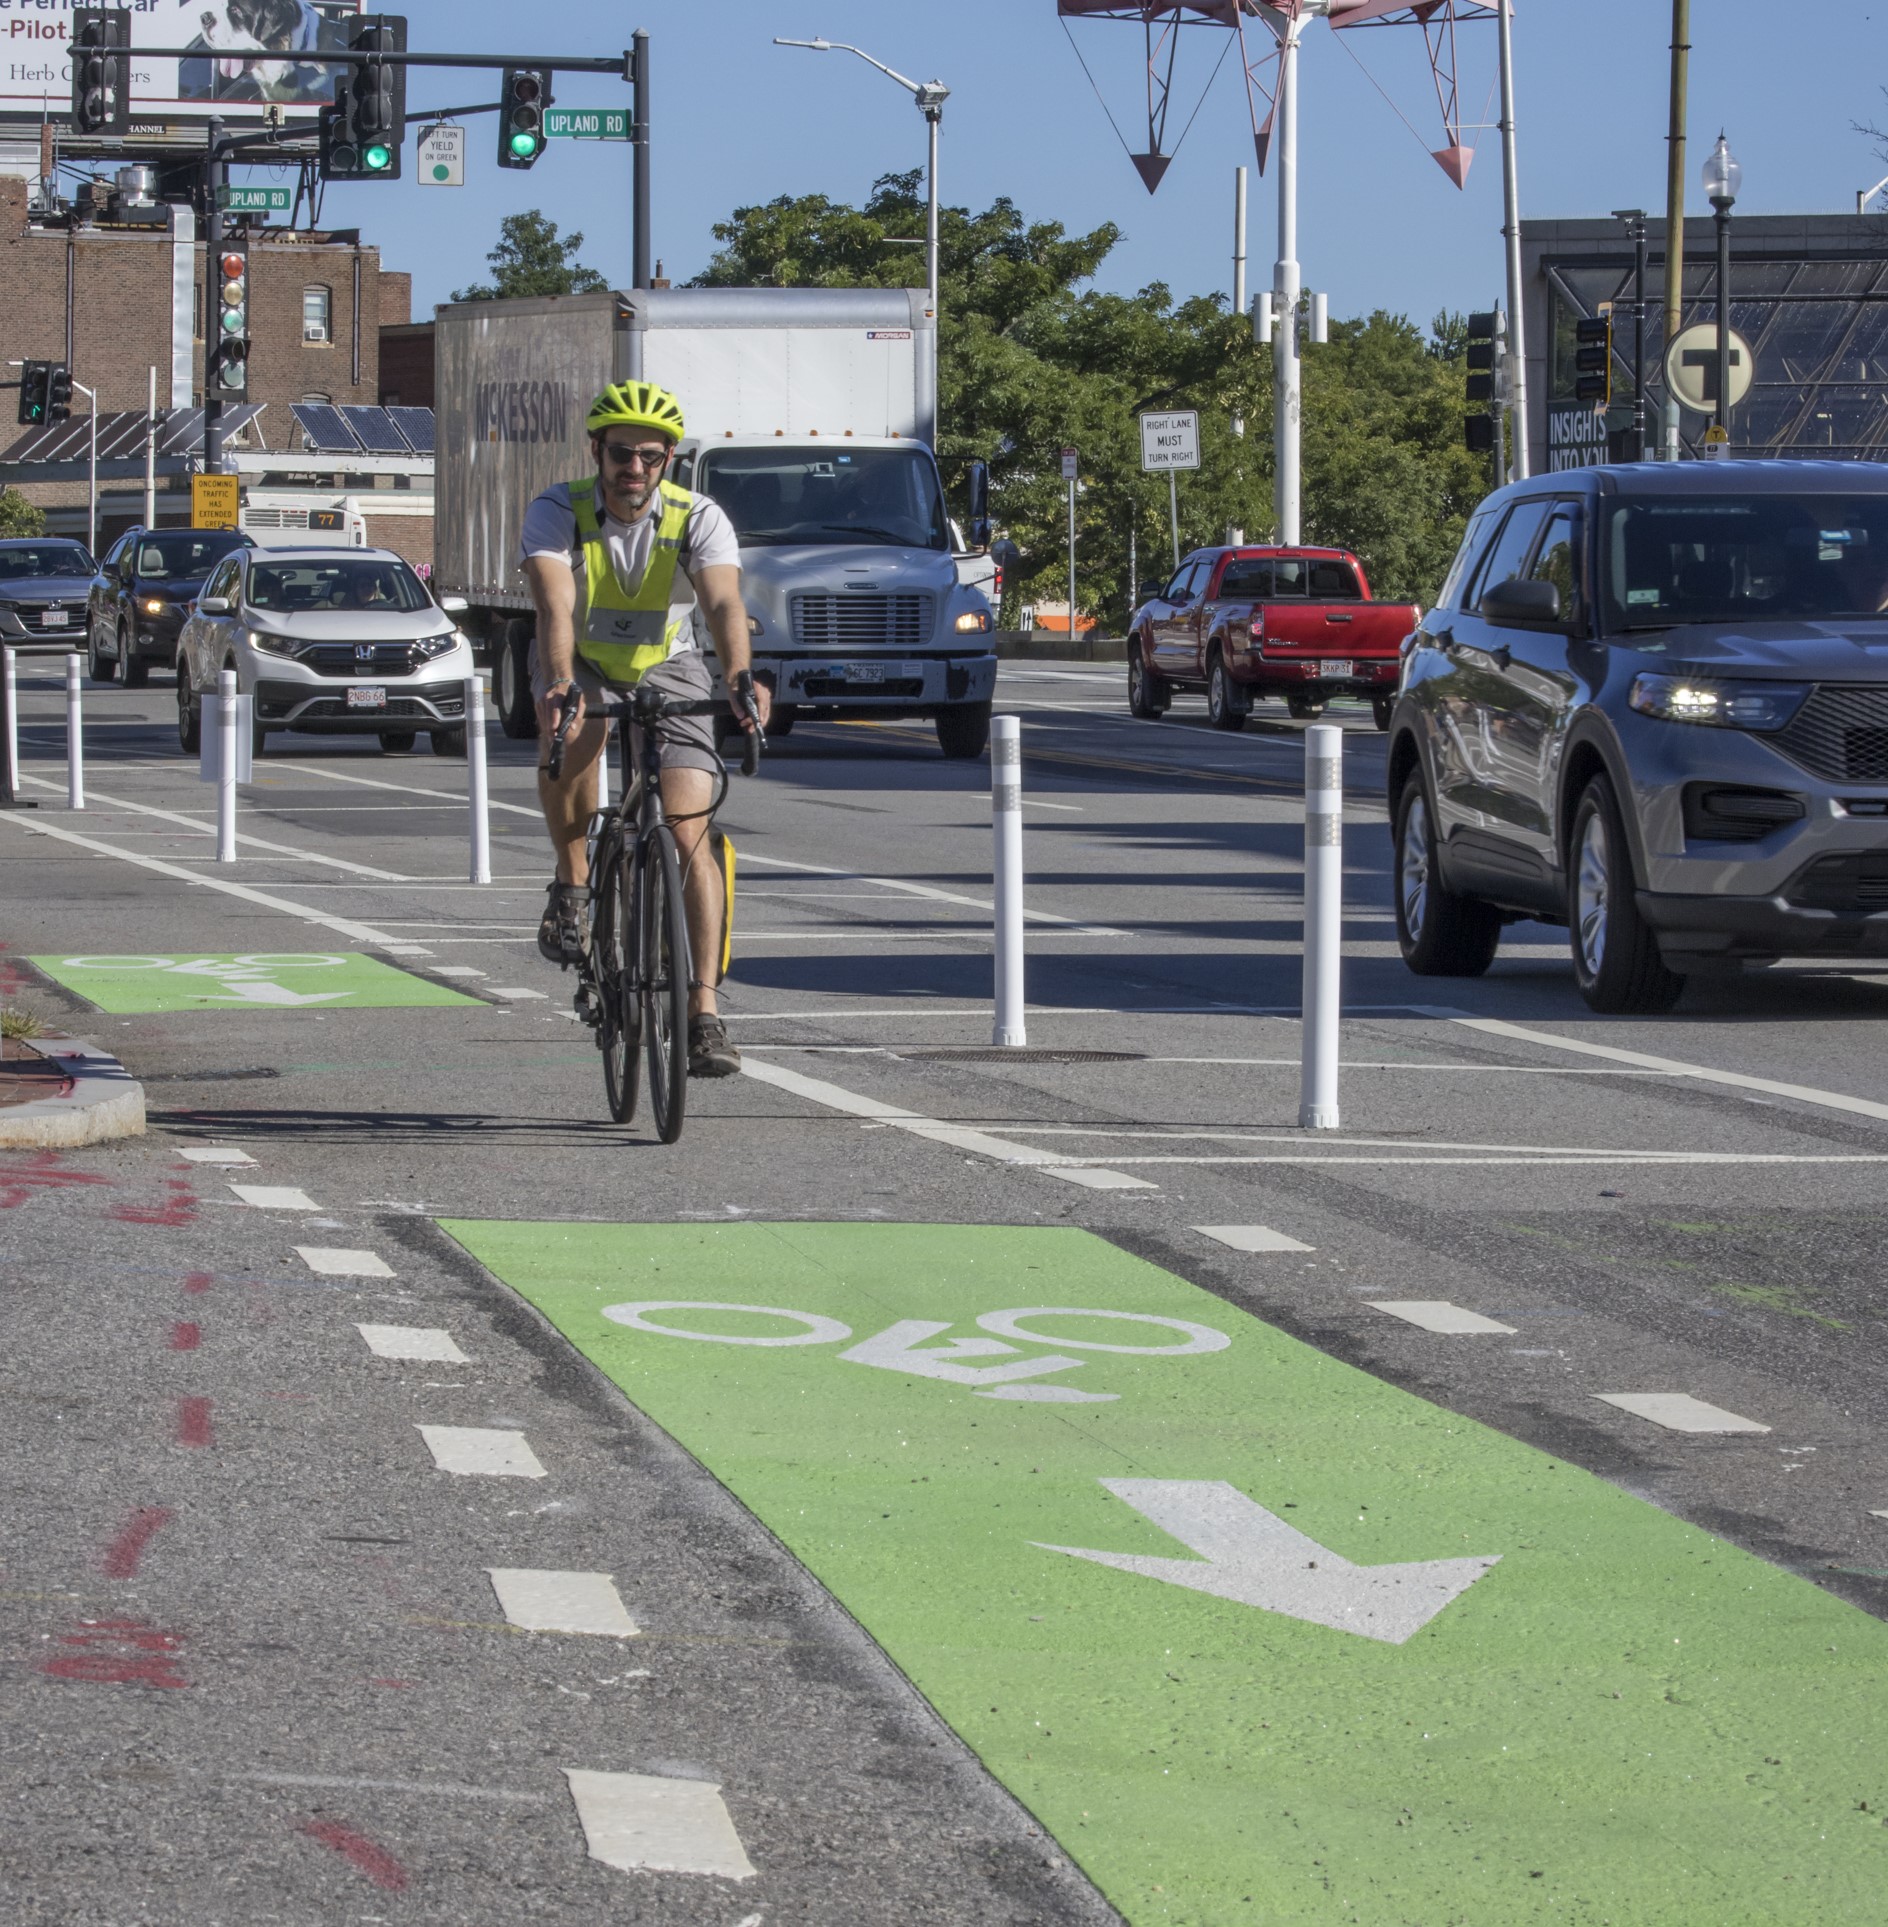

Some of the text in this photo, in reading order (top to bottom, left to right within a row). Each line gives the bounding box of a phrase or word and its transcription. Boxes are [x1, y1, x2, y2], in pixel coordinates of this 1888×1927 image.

[10, 64, 55, 81] Herb
[551, 115, 623, 132] UPLAND RD
[431, 141, 454, 151] YIELD
[425, 153, 434, 161] ON
[271, 192, 285, 206] RD
[1146, 419, 1192, 430] RIGHT LANE
[1157, 434, 1182, 447] MUST
[1148, 451, 1193, 463] TURN RIGHT
[198, 480, 233, 488] ONCOMING
[203, 490, 229, 498] TRAFFIC
[209, 500, 222, 508] HAS
[199, 510, 232, 518] EXTENDED
[318, 513, 335, 526] 77
[349, 691, 385, 702] 2NBG 66
